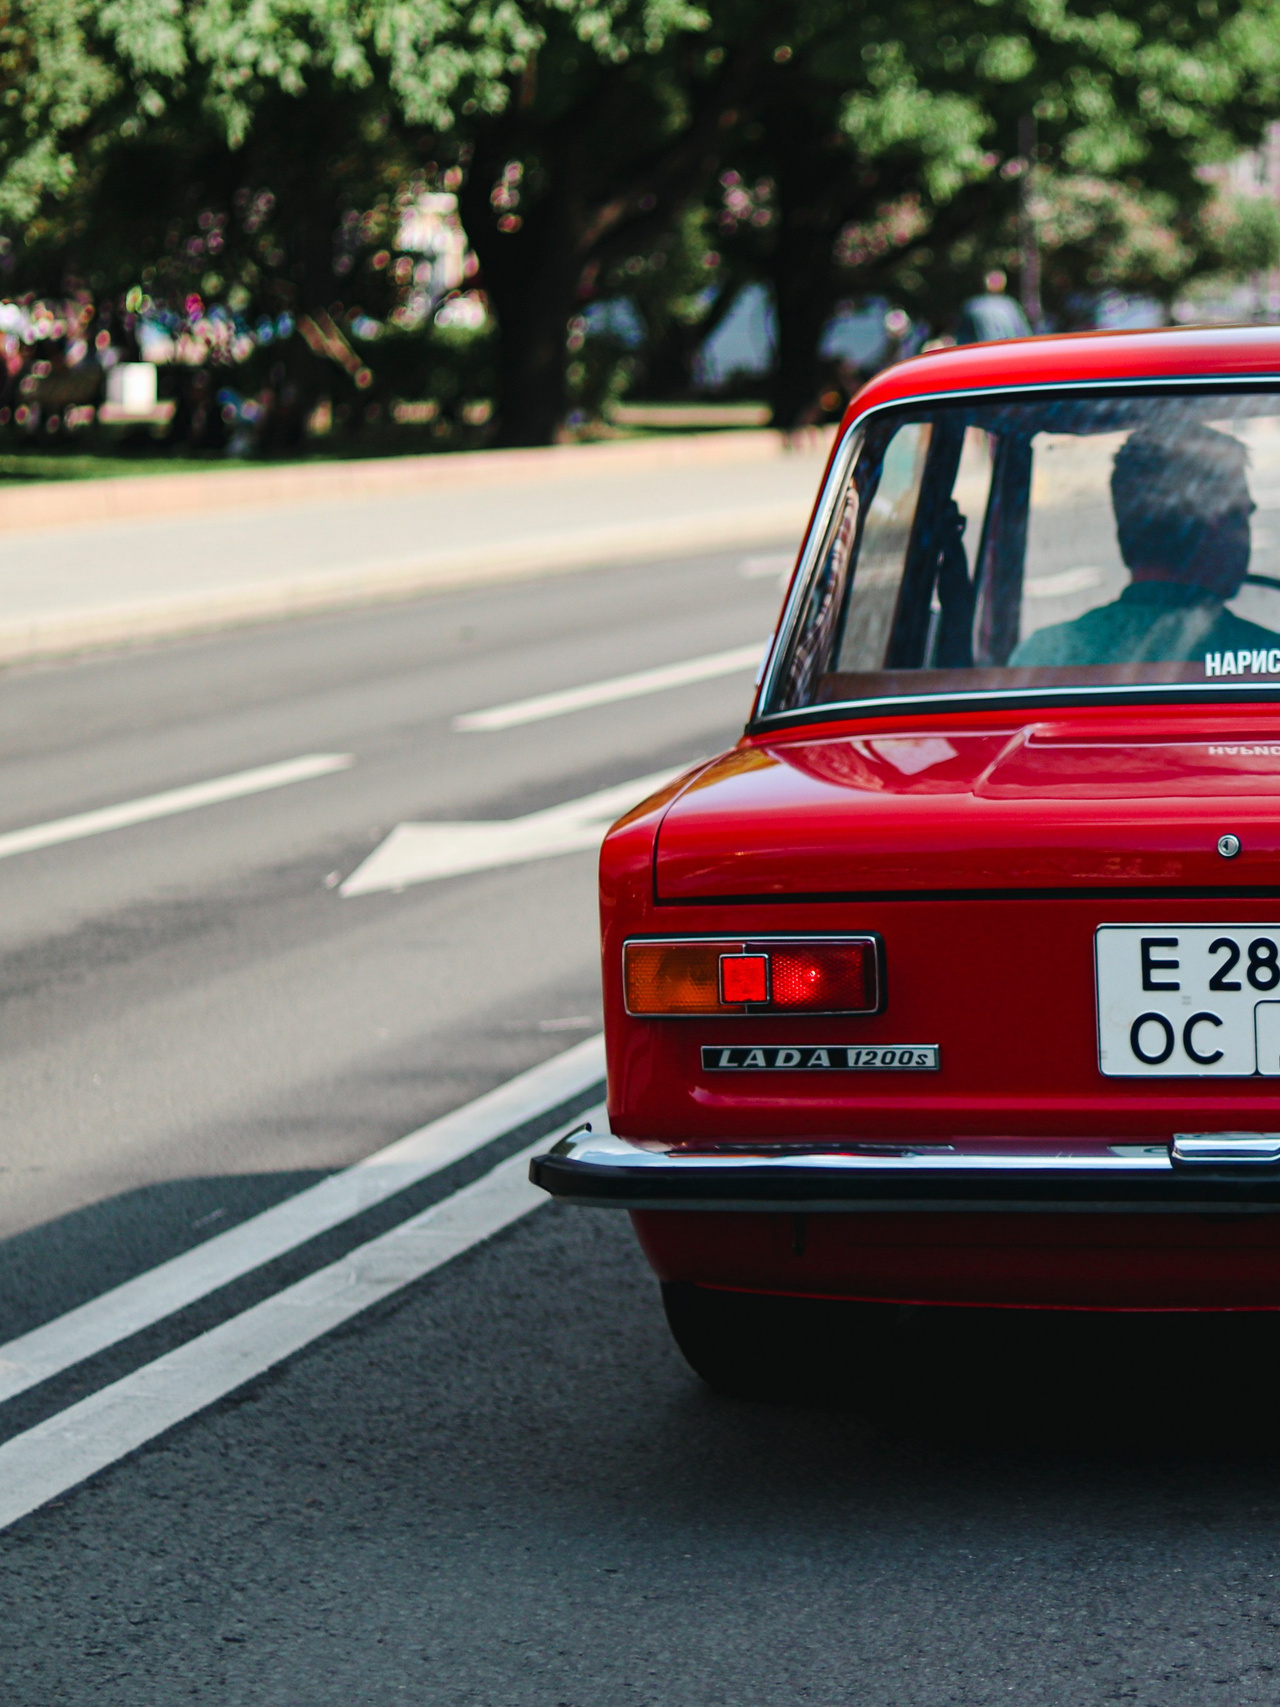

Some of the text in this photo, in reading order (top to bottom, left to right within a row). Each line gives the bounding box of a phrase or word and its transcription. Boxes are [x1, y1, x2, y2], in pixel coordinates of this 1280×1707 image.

[1140, 937, 1180, 991] E
[718, 1049, 929, 1067] LADA 1200s
[1130, 1011, 1224, 1065] OC
